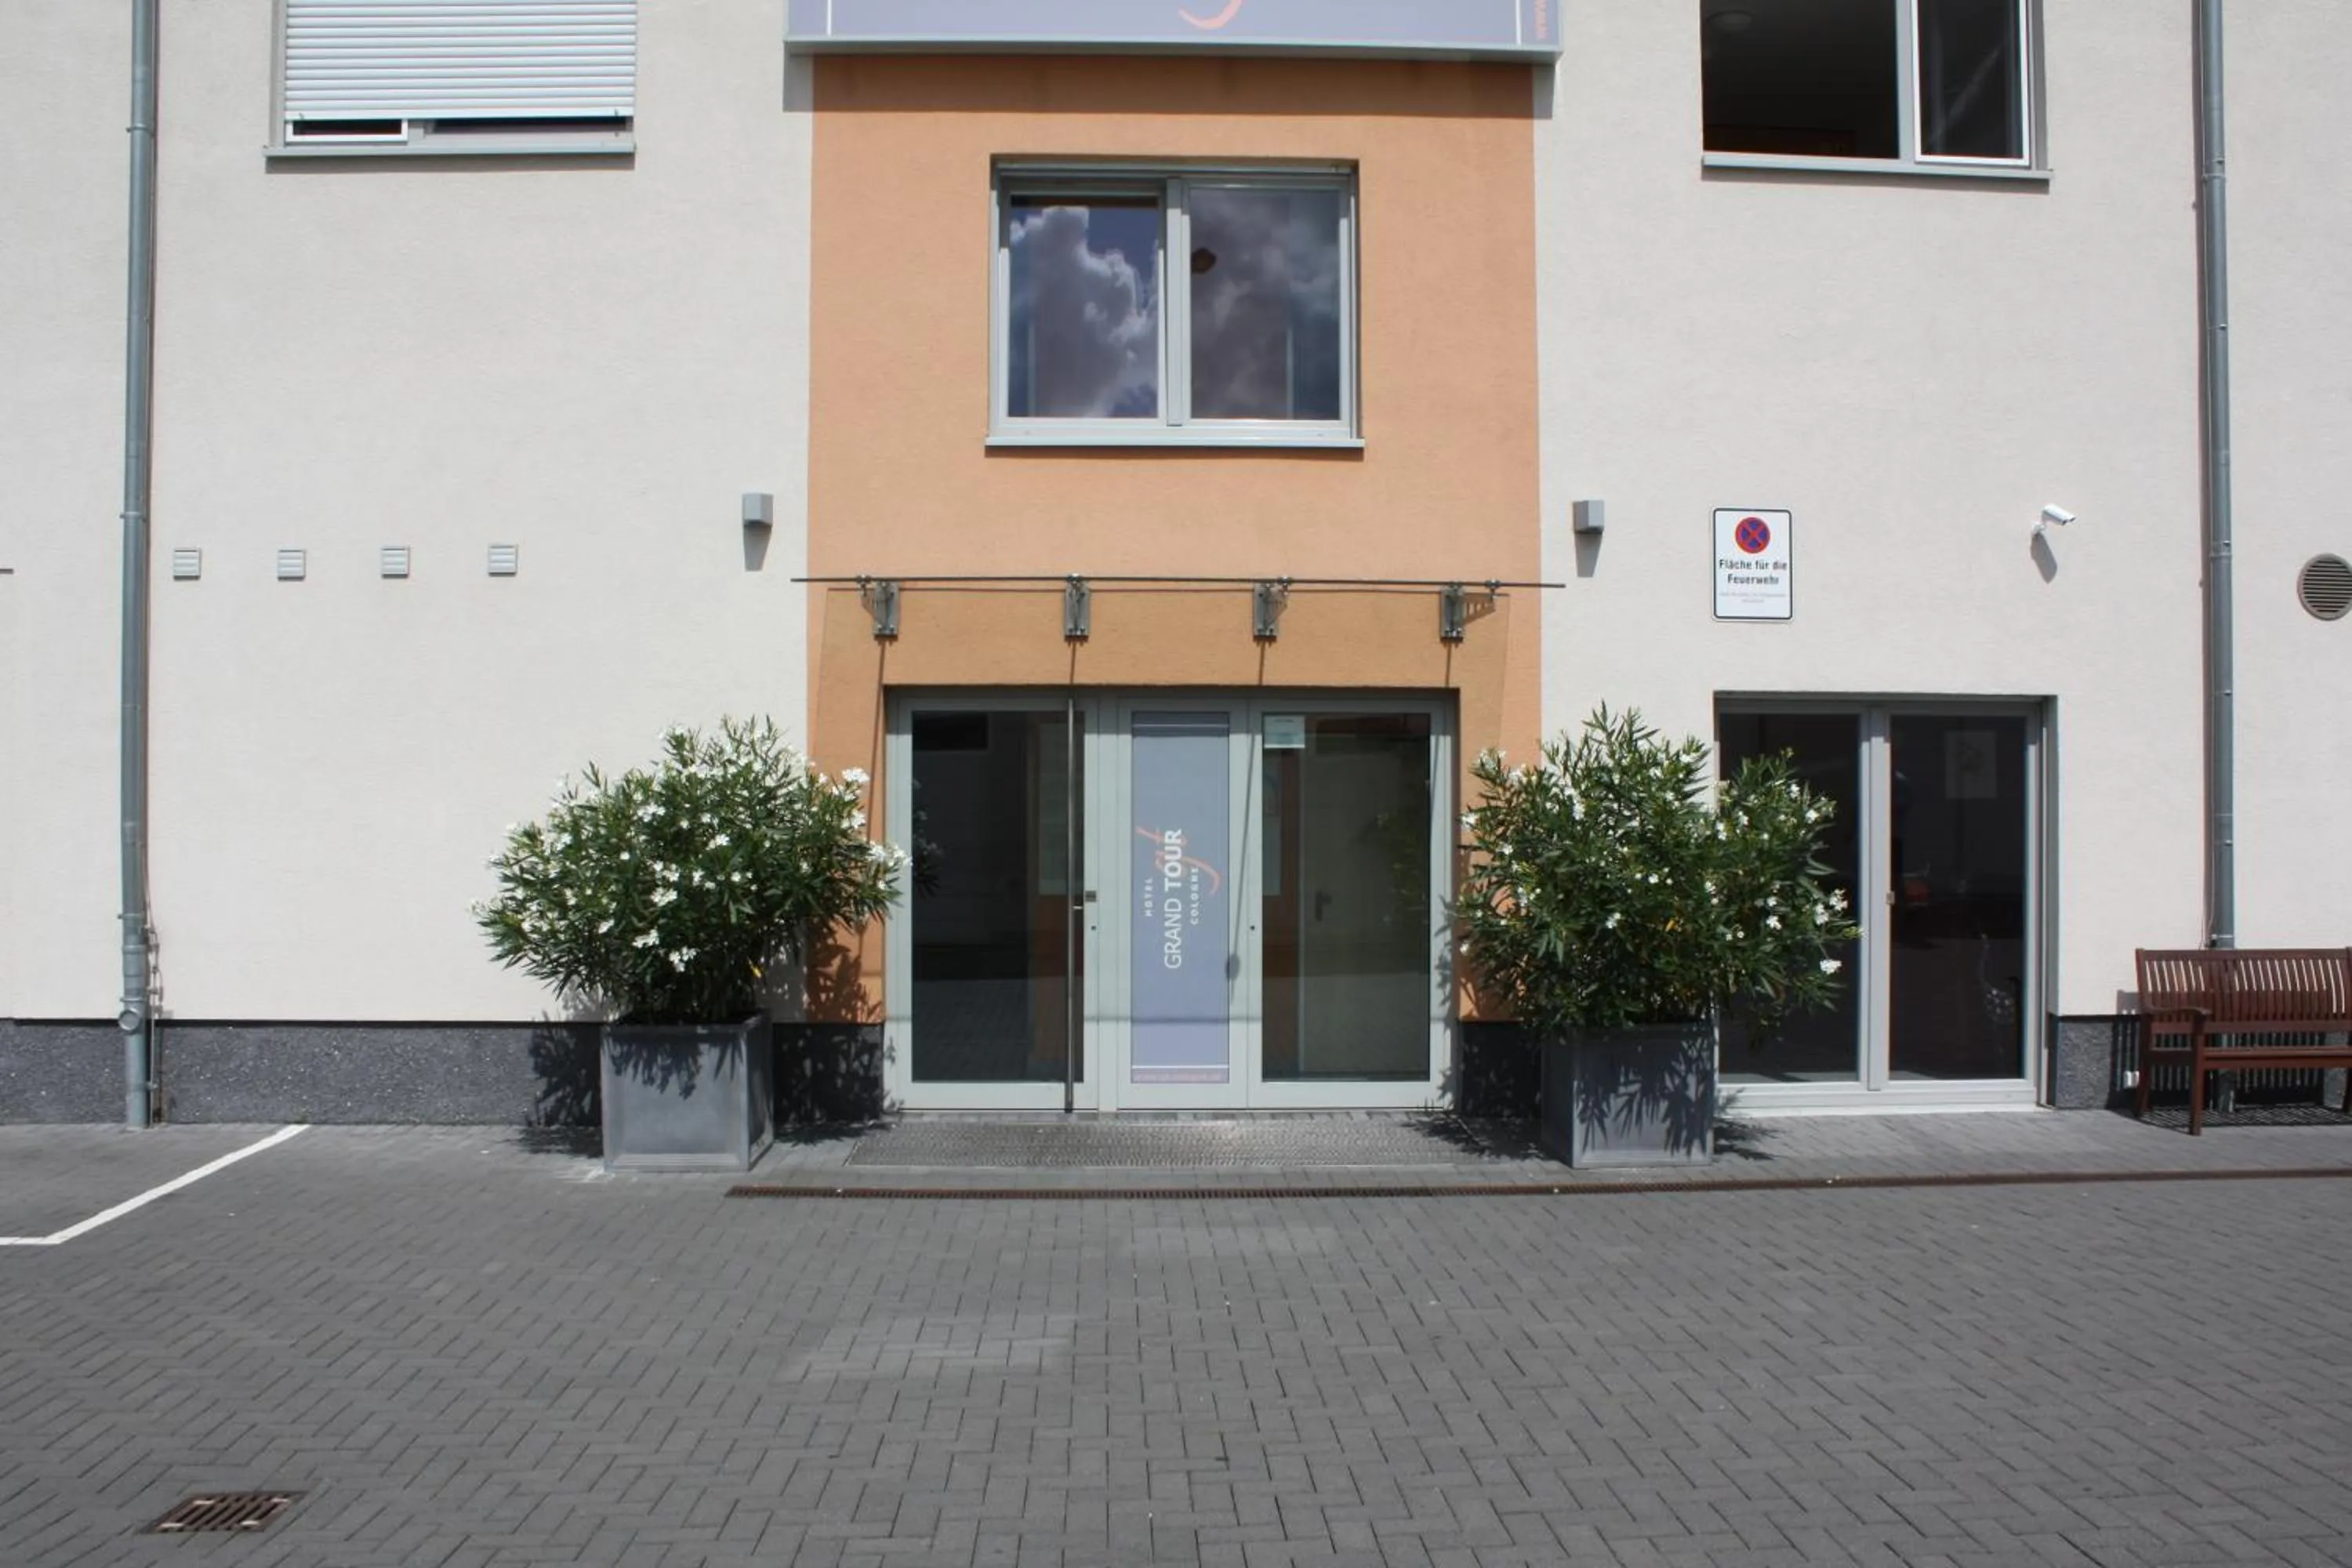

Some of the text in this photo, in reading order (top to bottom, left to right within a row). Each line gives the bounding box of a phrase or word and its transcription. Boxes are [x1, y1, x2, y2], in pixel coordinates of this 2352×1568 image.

[1719, 559, 1788, 571] Fläche für die
[1727, 573, 1779, 585] Feuerwehr
[1145, 877, 1153, 916] HOTEL
[1164, 829, 1182, 969] GRAND TOUR
[1190, 867, 1200, 925] COLOGNE
